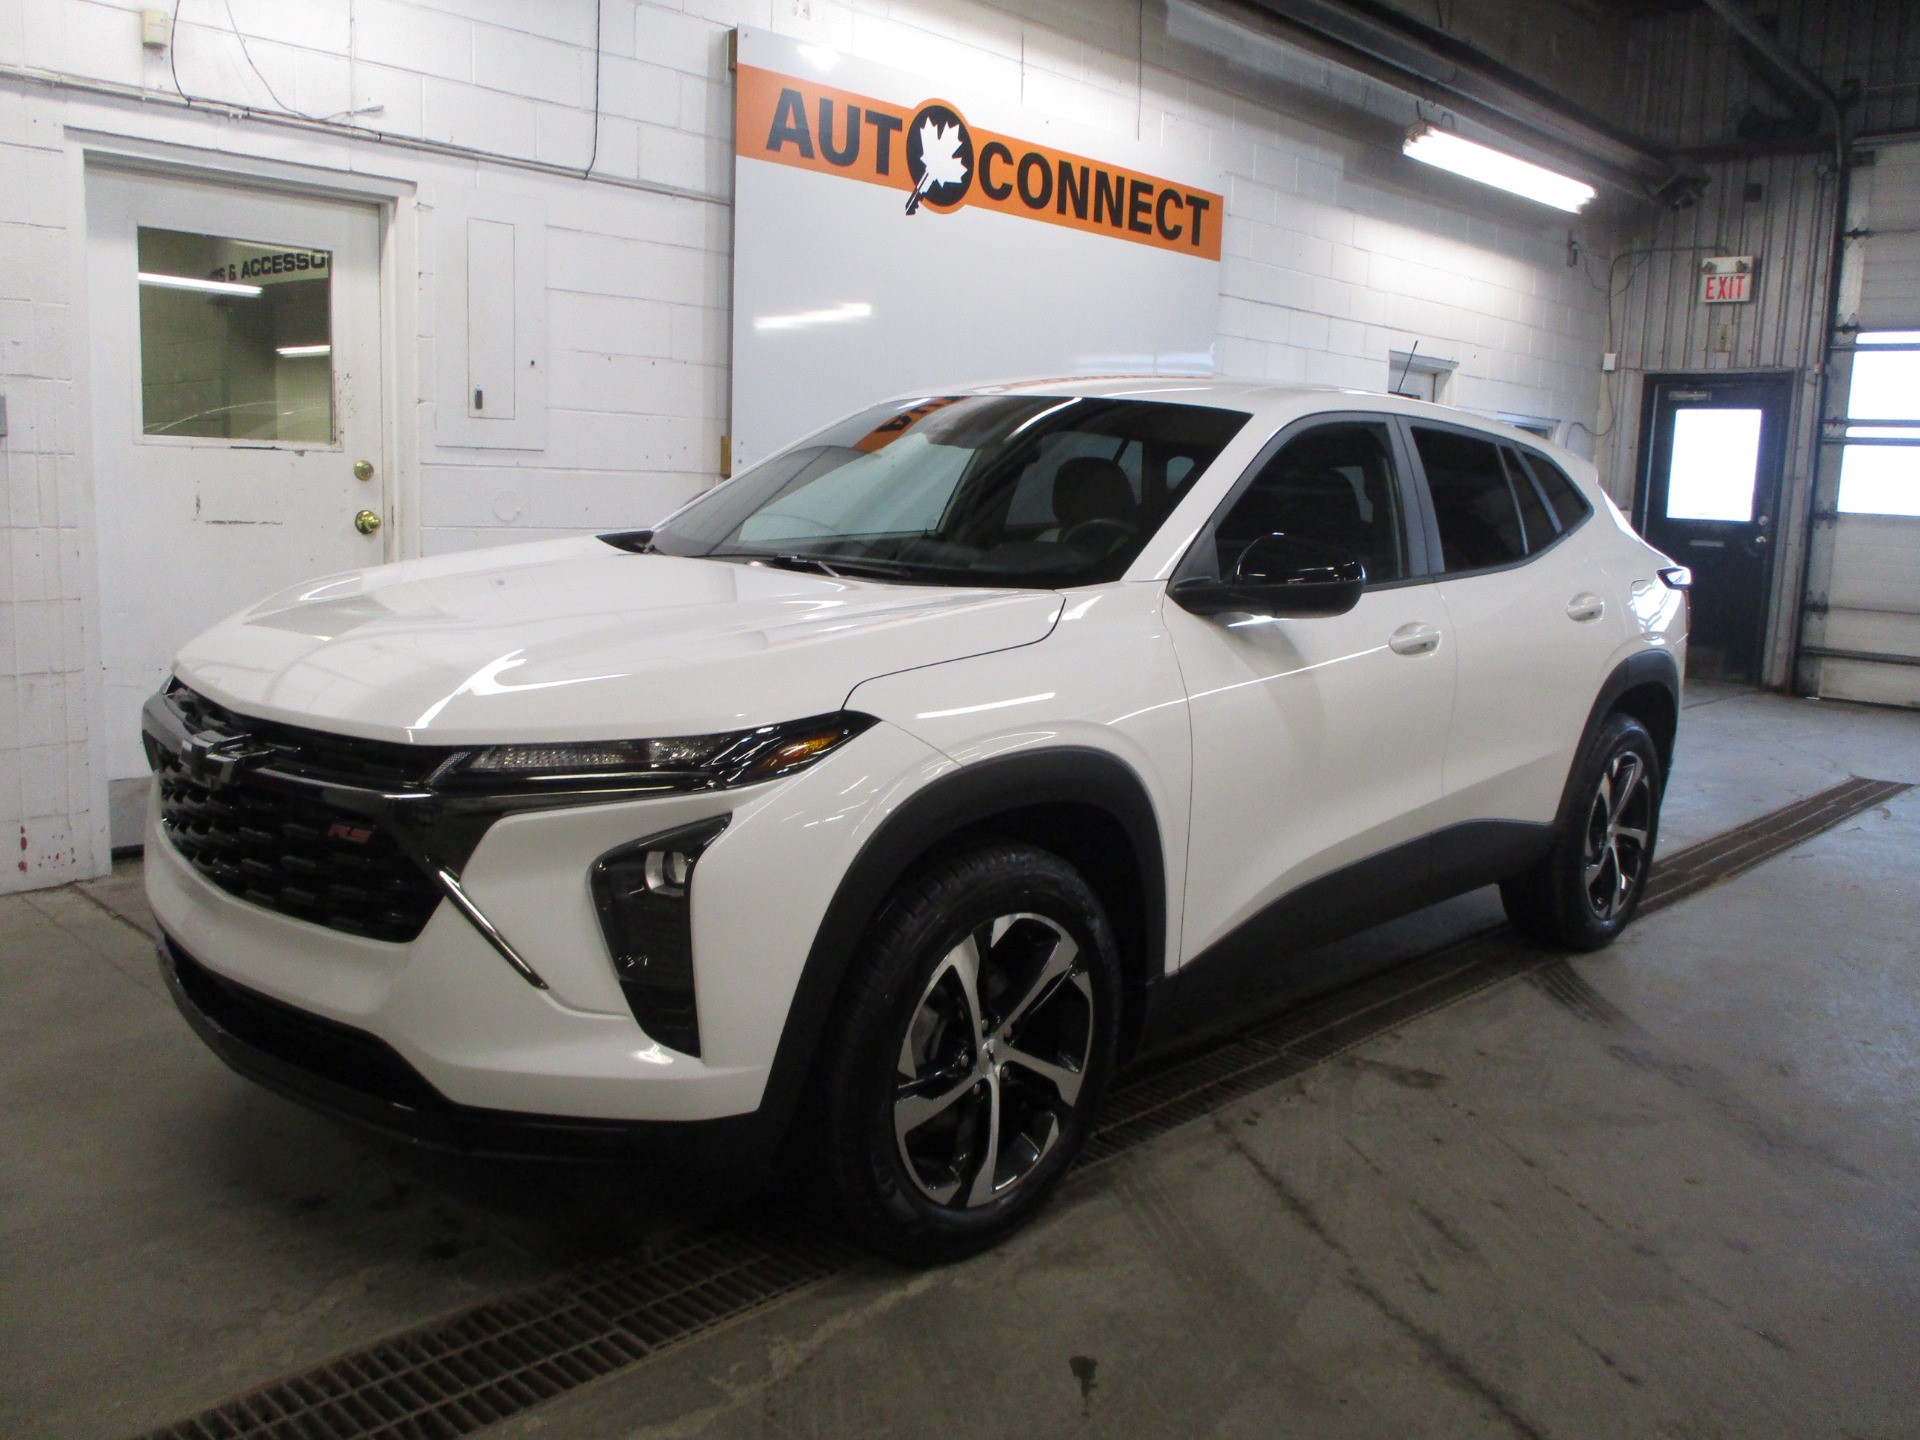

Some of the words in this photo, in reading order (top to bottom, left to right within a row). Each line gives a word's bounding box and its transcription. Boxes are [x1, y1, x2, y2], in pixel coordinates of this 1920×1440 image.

[978, 141, 1210, 247] CONNECT
[240, 251, 329, 279] ACCESSO
[1705, 275, 1746, 300] EXIT
[327, 824, 372, 844] RS
